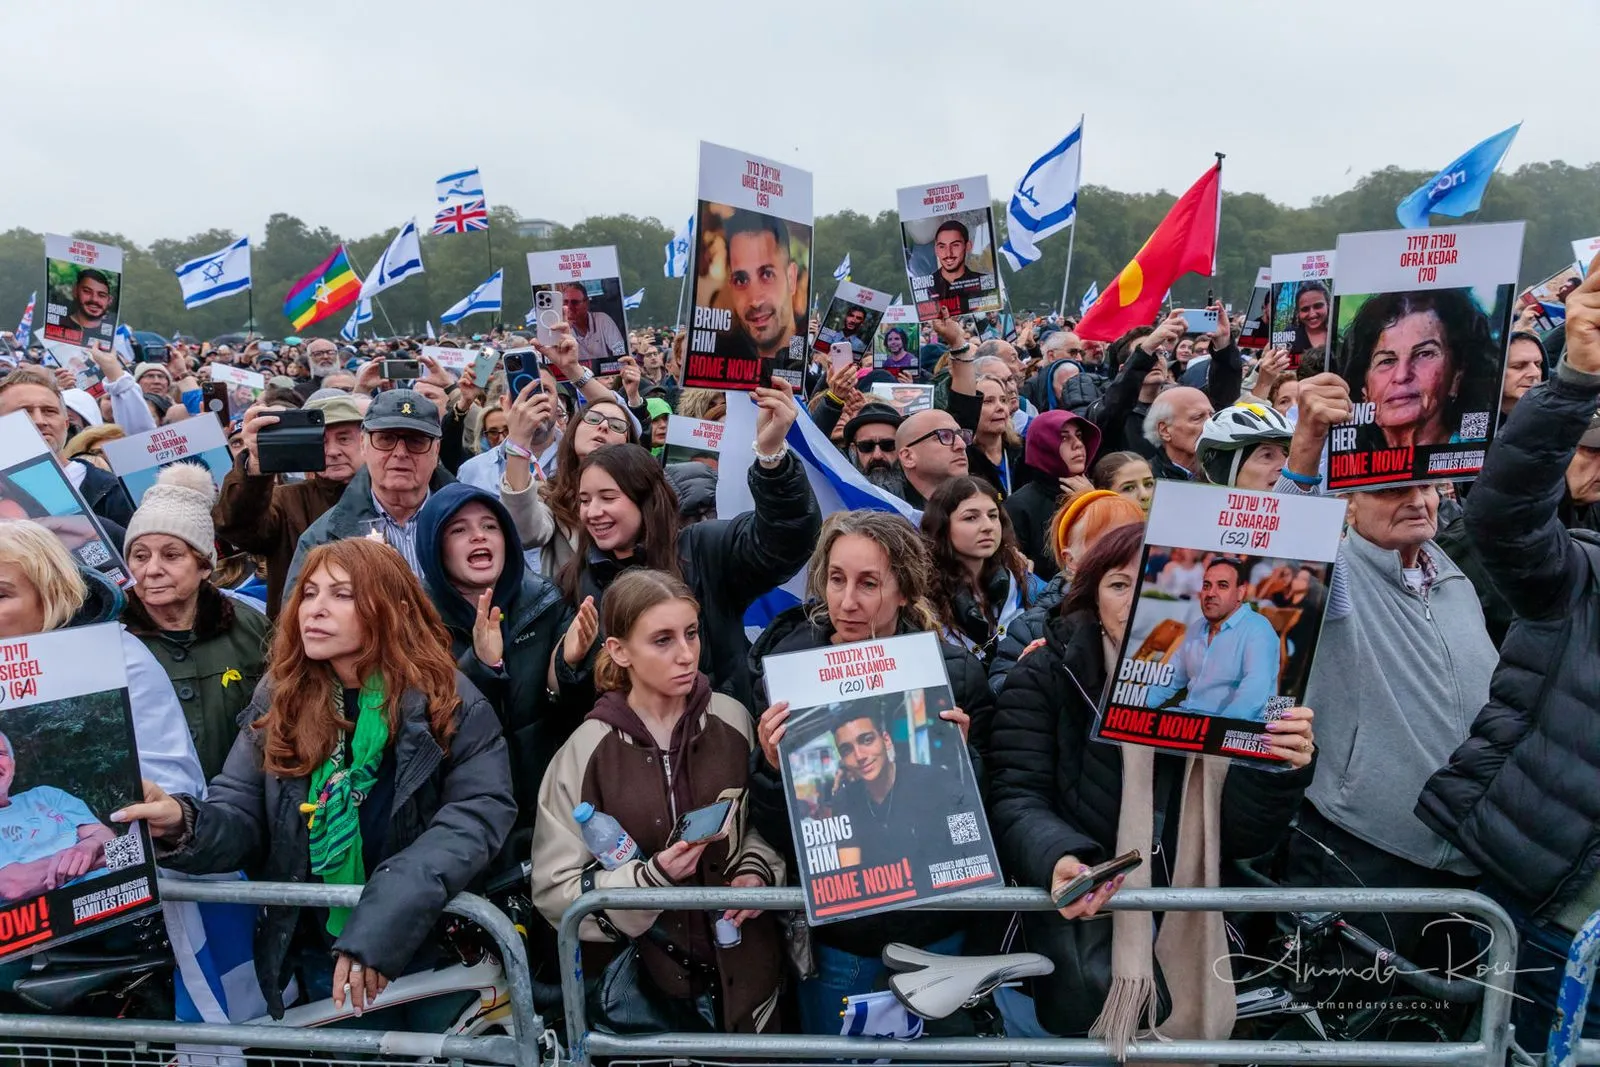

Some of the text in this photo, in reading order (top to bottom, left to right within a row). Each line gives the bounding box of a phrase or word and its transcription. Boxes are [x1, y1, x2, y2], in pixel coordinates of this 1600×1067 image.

[742, 173, 784, 197] URIEL BARUCH
[756, 192, 770, 208] (35)
[1407, 233, 1456, 251] עפרה קידר
[1400, 250, 1458, 267] OFRA KEDAR
[1418, 266, 1437, 284] (70)
[694, 306, 732, 332] BRING
[691, 330, 717, 353] HIM
[1272, 330, 1296, 342] BRING
[688, 355, 725, 378] HOME
[726, 359, 762, 382] NOW!
[1332, 402, 1376, 427] ING
[147, 436, 188, 454] GALI BERMAN
[1332, 428, 1358, 452] HER
[1331, 444, 1413, 478] HOME NOW!
[1428, 457, 1485, 472] FAMILIES FORUM
[1228, 494, 1280, 514] אלי שרעבי
[1218, 510, 1280, 531] ELI SHARABI
[1220, 530, 1249, 548] (52)
[824, 645, 885, 666] עידן אלכסנדר
[0, 660, 43, 681] SIEGEL
[819, 658, 897, 682] EDAN ALEXANDER
[1118, 658, 1175, 687] BRING
[839, 678, 865, 696] (20)
[1112, 681, 1149, 708] HIM
[1105, 706, 1211, 742] HOME NOW!
[1222, 737, 1257, 752] FAMILIES
[800, 814, 853, 848] BRING
[806, 843, 841, 875] HIM
[928, 860, 956, 873] HOSTAGES
[966, 854, 990, 866] MISSING
[811, 857, 914, 905] HOME NOW!
[931, 862, 993, 886] FAMILIES FORUM
[72, 876, 148, 909] HOSTAGES AND MISSING
[74, 885, 150, 921] FAMILIES FORUM
